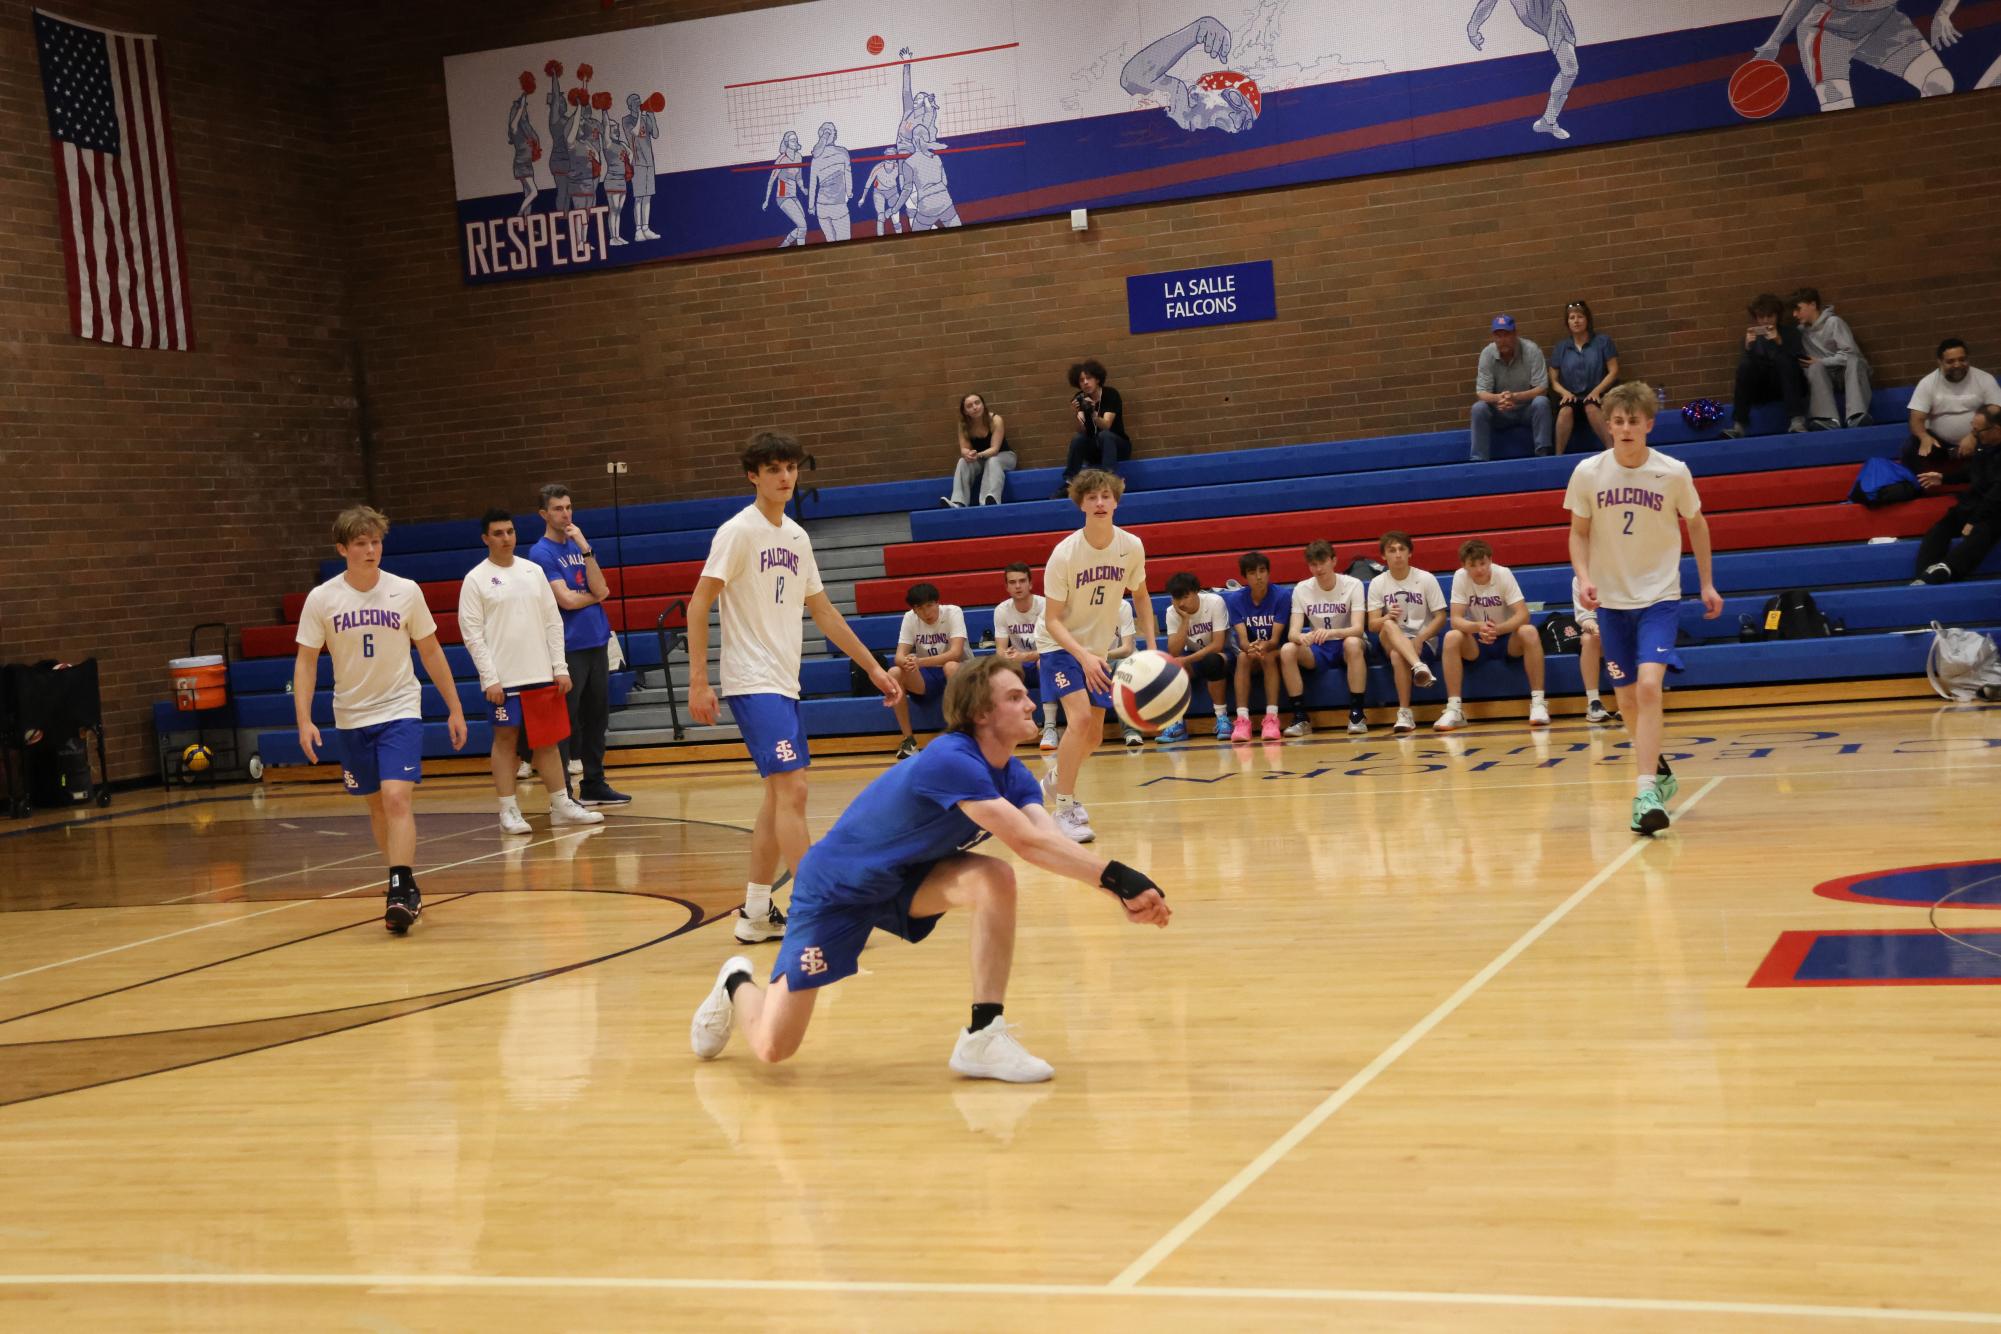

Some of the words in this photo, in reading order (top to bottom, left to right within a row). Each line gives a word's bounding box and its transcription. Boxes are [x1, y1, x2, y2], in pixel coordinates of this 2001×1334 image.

[464, 205, 609, 276] RESPECT
[1164, 281, 1185, 299] LA
[1188, 275, 1236, 296] SALLE
[1166, 296, 1237, 319] FALCONS
[1597, 487, 1664, 511] FALCONS
[1623, 511, 1634, 535] 2
[760, 547, 799, 576] FALCONS
[1076, 565, 1125, 589] FALCONS
[1090, 586, 1105, 606] 15
[333, 609, 400, 634] FALCONS
[1307, 603, 1347, 616] FALCONS
[1324, 617, 1331, 629] 8
[363, 633, 374, 657] 6
[916, 633, 949, 645] FALCONS
[1020, 638, 1032, 650] 14
